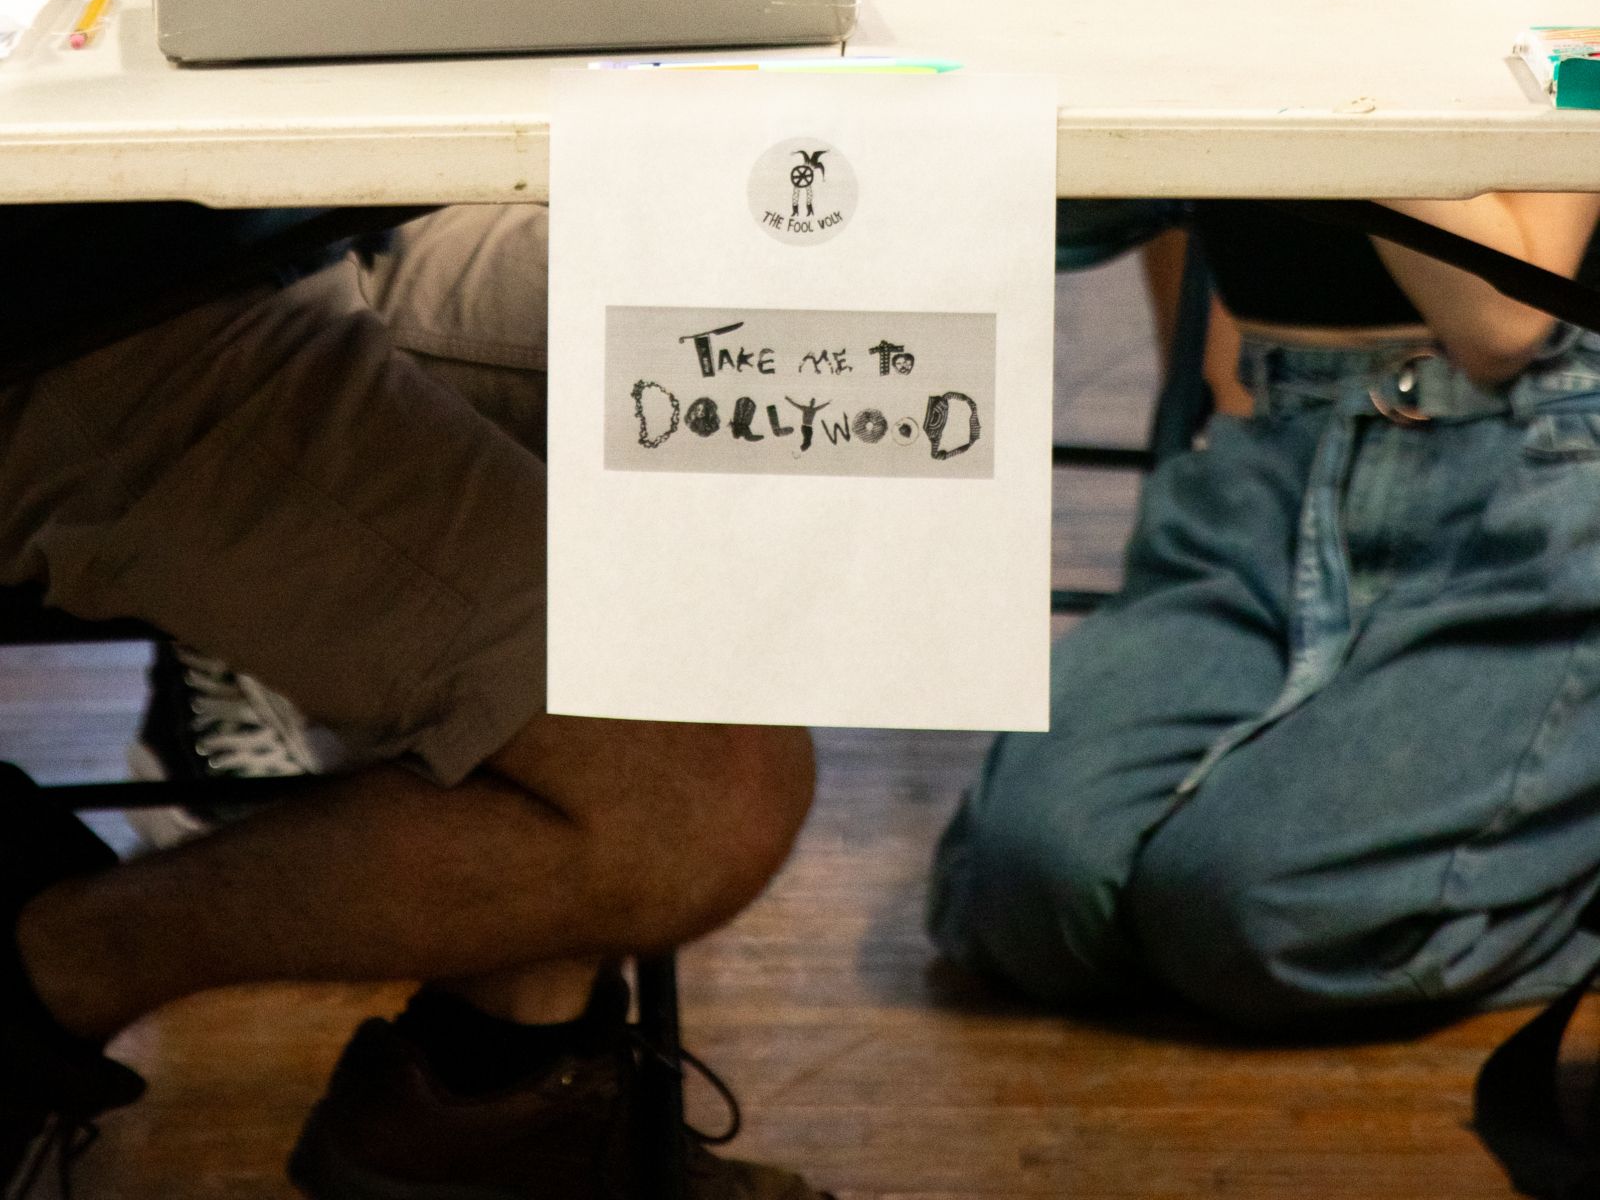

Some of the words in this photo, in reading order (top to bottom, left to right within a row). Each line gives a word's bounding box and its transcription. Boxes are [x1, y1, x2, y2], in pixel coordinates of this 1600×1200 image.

[762, 211, 784, 230] THE
[787, 218, 814, 233] FOOL
[817, 211, 843, 229] VOLK
[679, 321, 776, 377] TAKE
[798, 348, 854, 376] ME
[868, 339, 915, 377] TO
[630, 378, 982, 461] DOLLYWOOD
